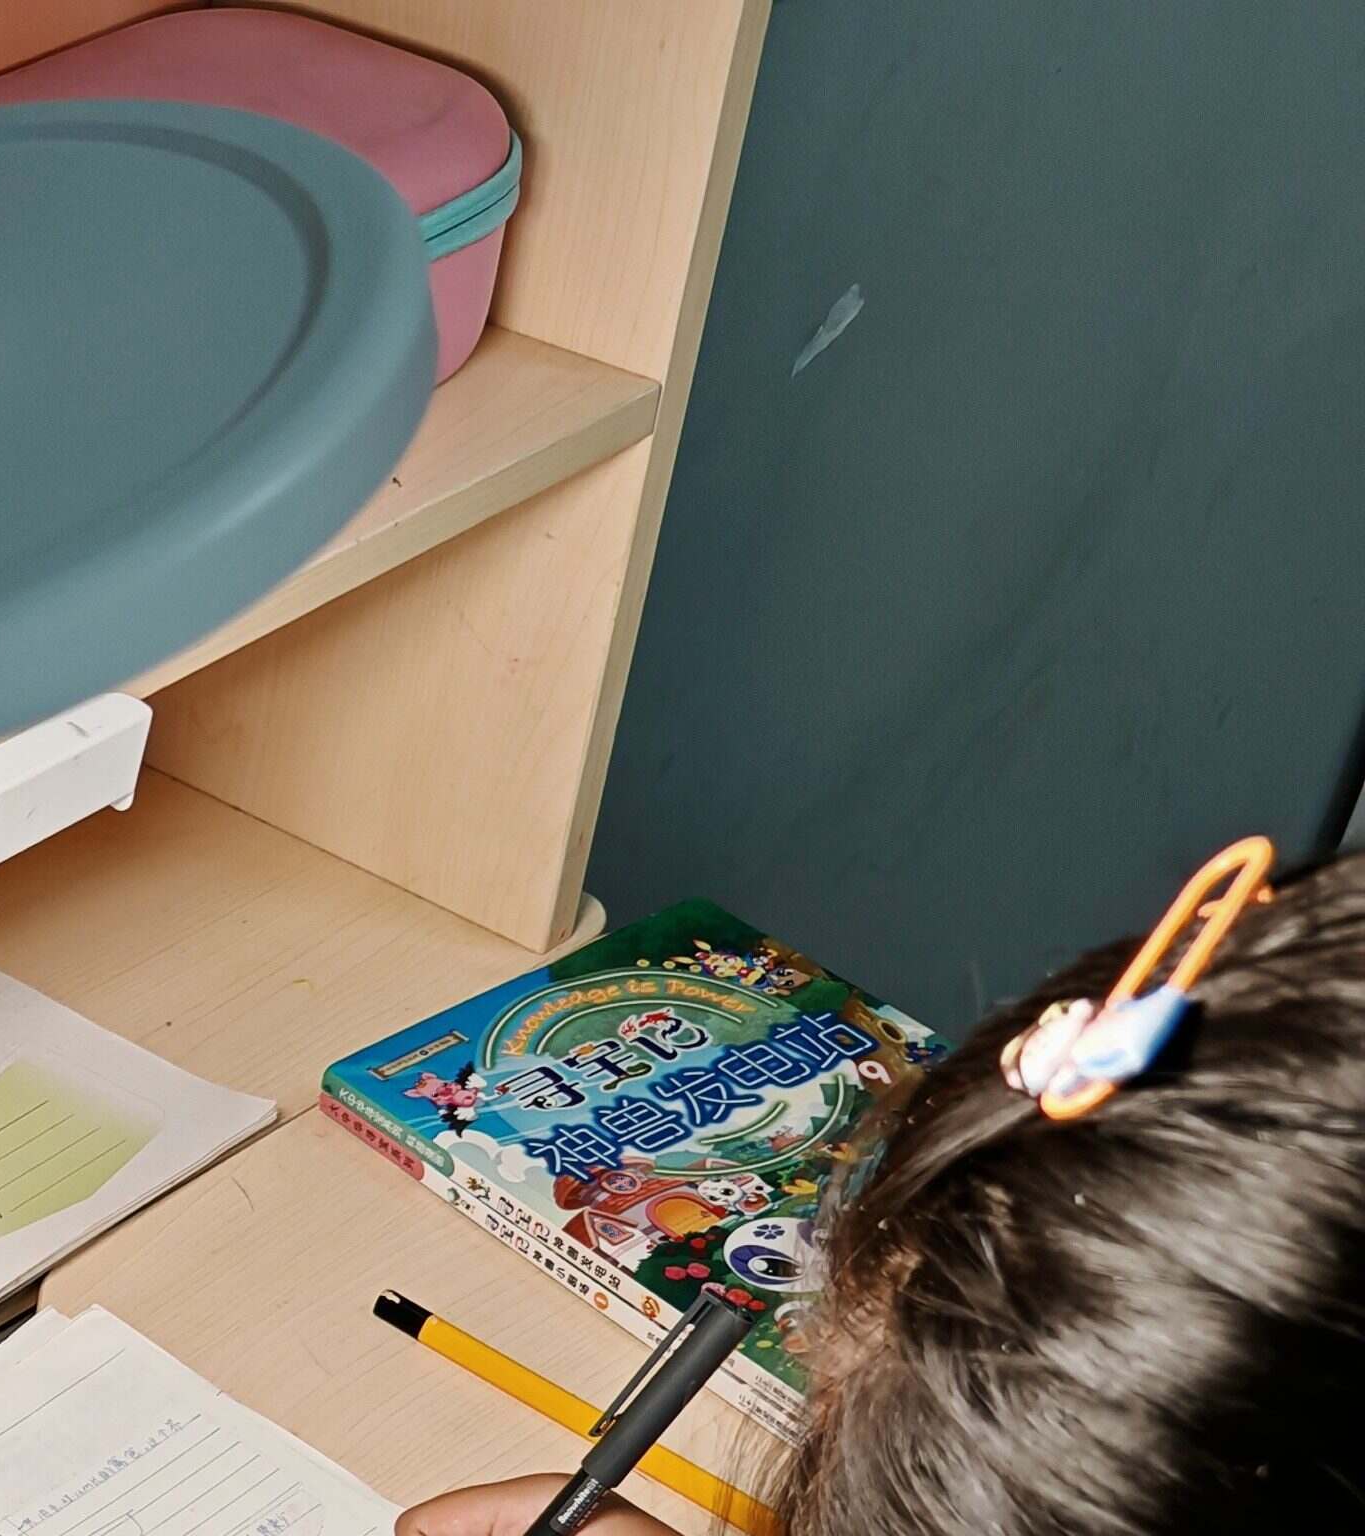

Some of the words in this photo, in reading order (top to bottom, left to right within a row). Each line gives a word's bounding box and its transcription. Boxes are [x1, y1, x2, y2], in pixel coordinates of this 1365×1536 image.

[495, 1009, 710, 1112] 寻宝记
[502, 985, 621, 1057] Knowledge
[623, 978, 659, 997] is
[666, 979, 757, 1014] Power
[527, 1012, 874, 1182] 神兽发电站
